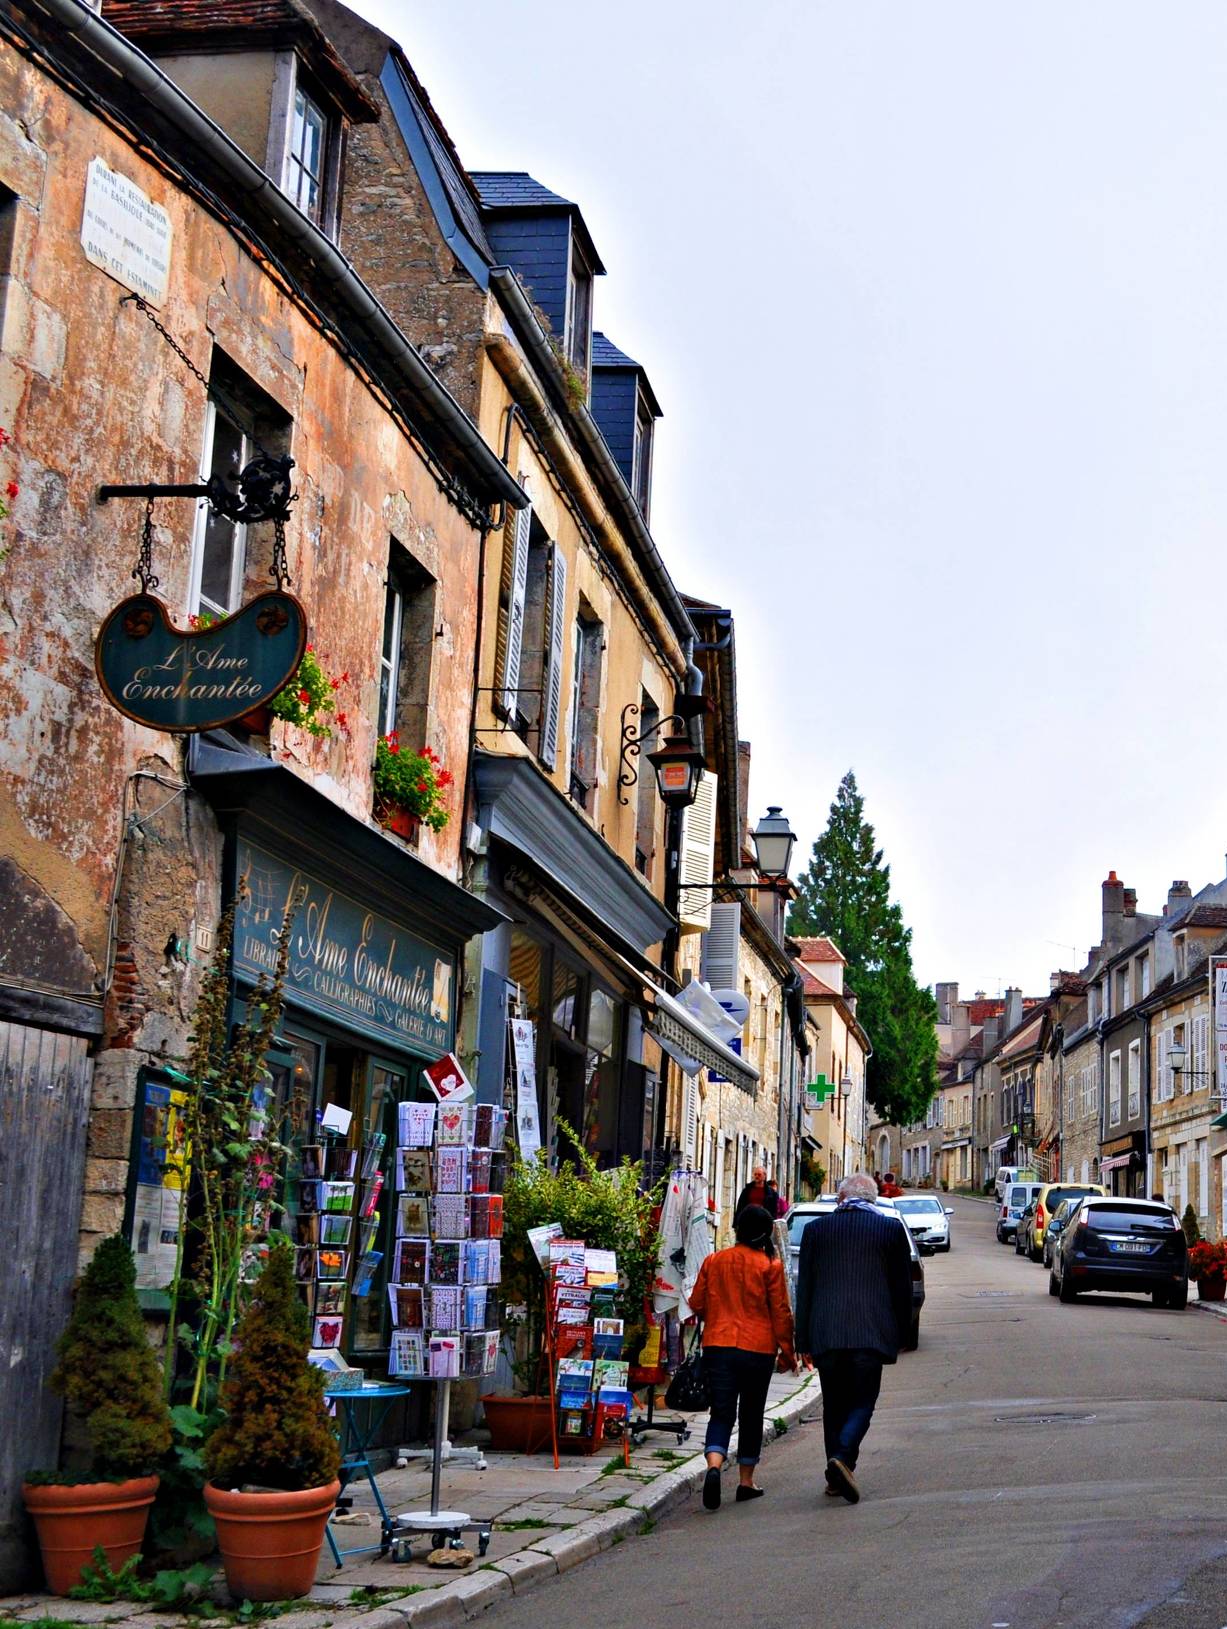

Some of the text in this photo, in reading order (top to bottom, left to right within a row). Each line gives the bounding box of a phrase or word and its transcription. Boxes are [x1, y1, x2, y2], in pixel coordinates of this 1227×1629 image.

[88, 241, 109, 264] DANS
[153, 643, 249, 671] L'Ame
[122, 666, 263, 700] Enchantée
[353, 913, 434, 1016] Enchantée
[313, 971, 377, 1017] CALLIGRAPHIES
[394, 1009, 425, 1038] GALERIE
